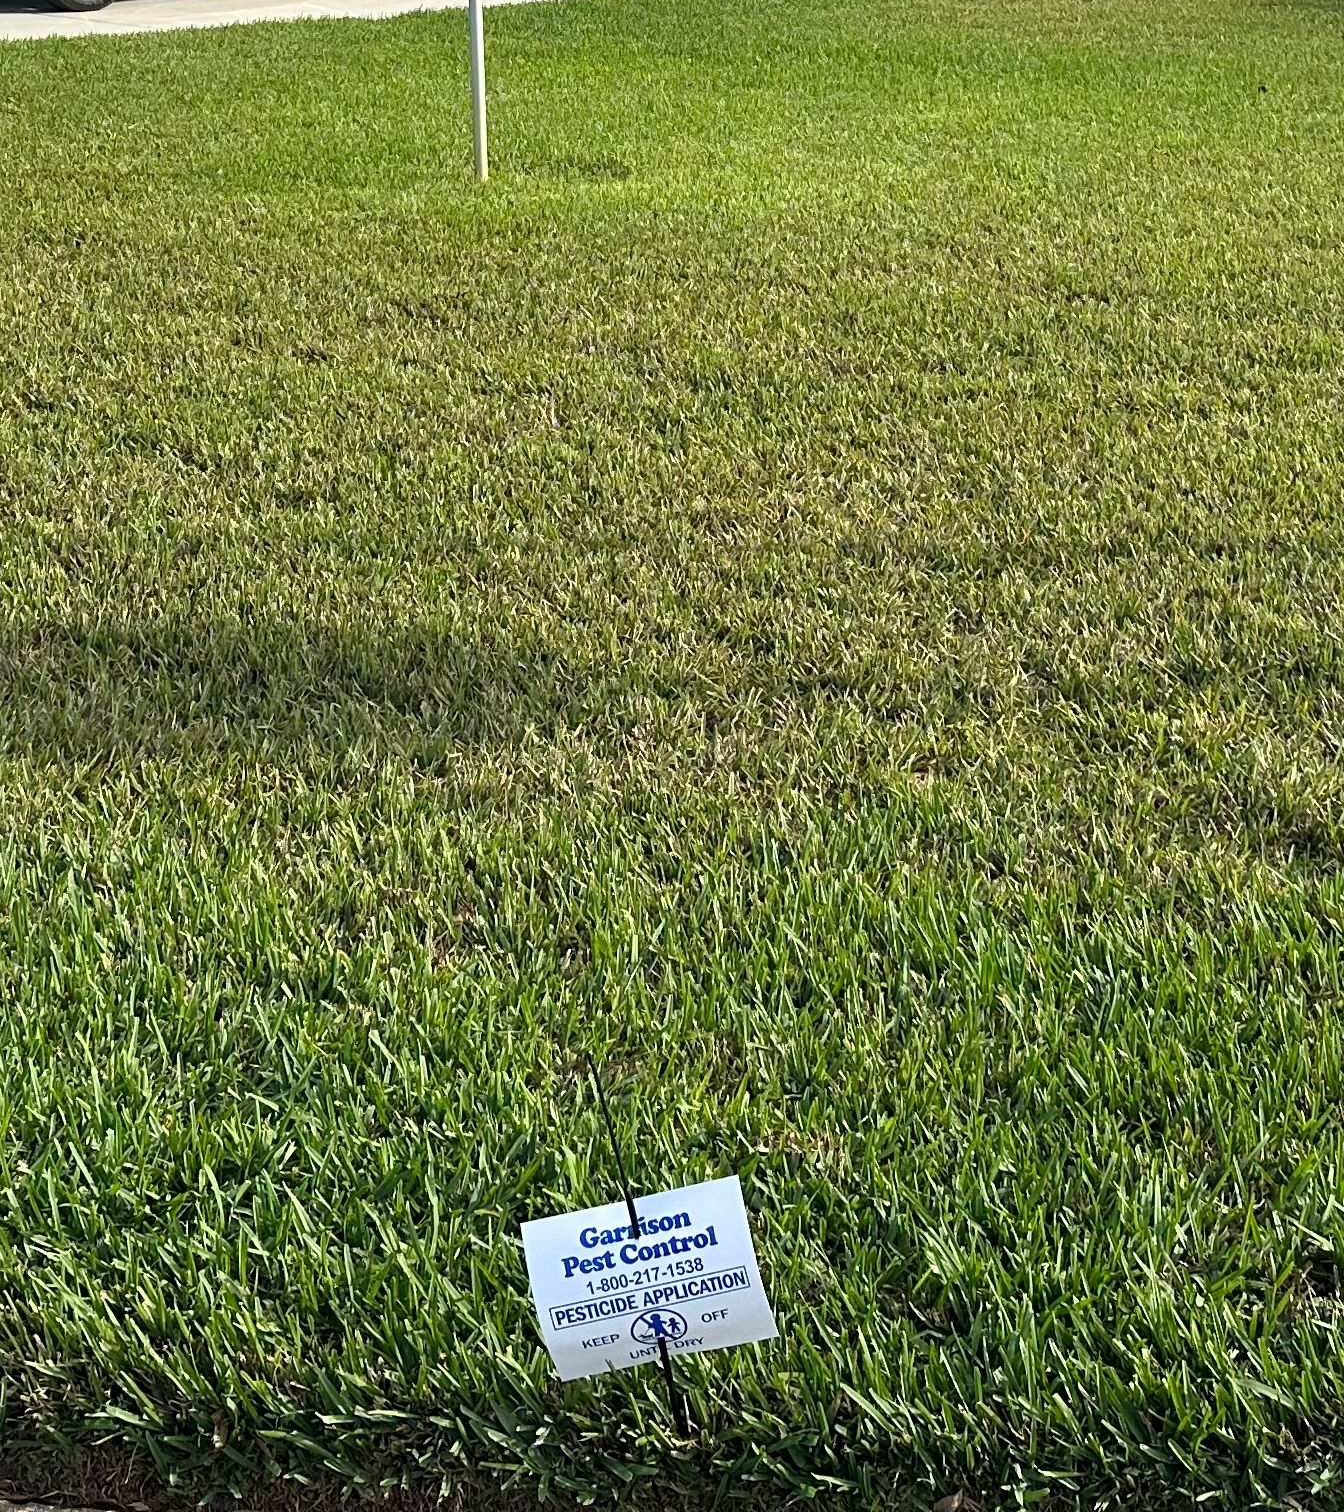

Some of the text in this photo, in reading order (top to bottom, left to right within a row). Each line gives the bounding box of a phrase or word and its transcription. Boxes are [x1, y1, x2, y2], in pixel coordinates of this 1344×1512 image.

[561, 1225, 718, 1278] Pest Control
[586, 1257, 704, 1295] 1-800-217-1538
[554, 1270, 746, 1326] PESTICIDE APPLICATION
[581, 1309, 729, 1349] KEEP OFF
[673, 1337, 705, 1349] DRY
